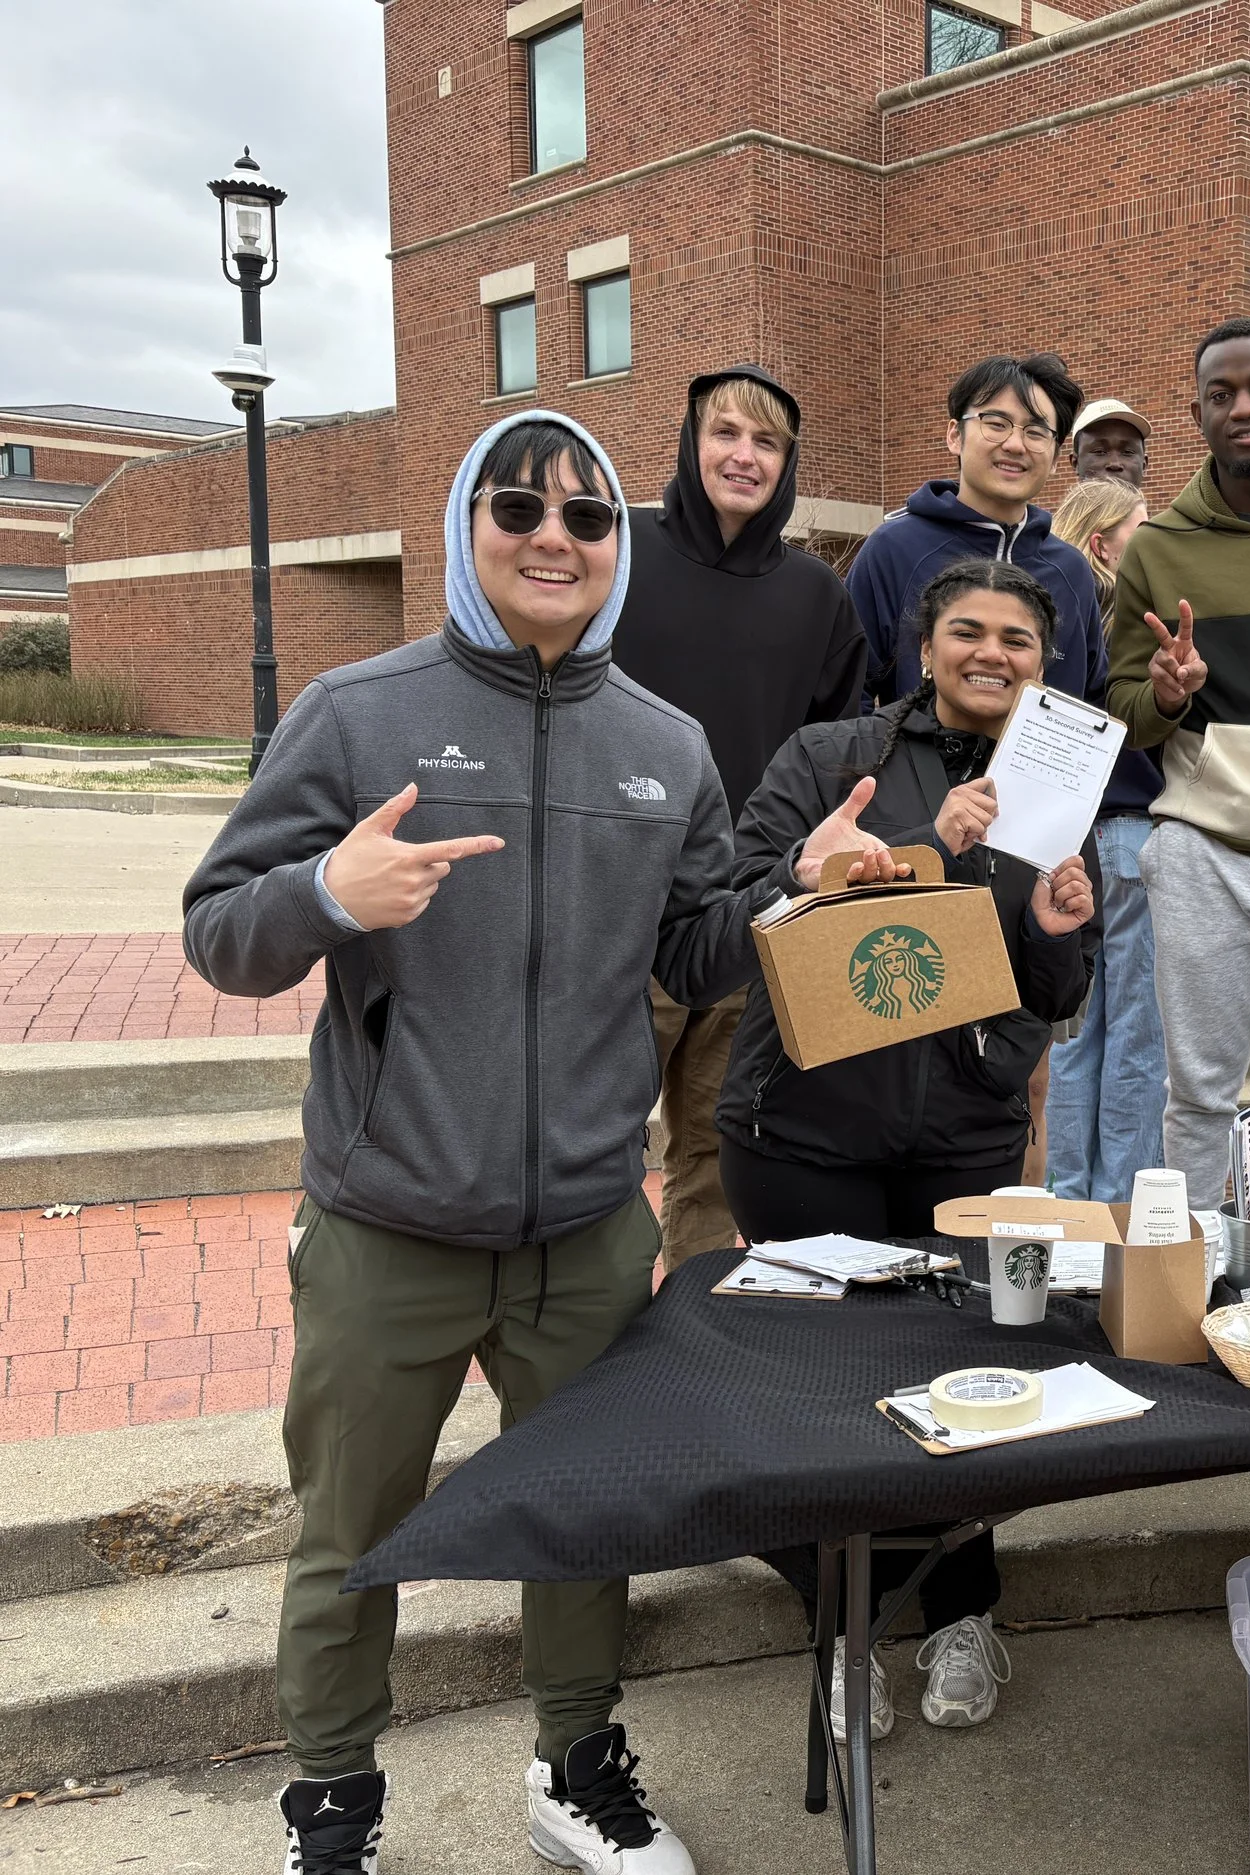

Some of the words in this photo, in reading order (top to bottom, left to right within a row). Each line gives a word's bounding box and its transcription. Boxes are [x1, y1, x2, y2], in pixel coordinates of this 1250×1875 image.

[1075, 727, 1095, 740] Survey
[418, 758, 486, 770] PHYSICIANS
[630, 775, 649, 786] THE
[618, 781, 649, 794] NORTH
[627, 790, 650, 800] FACE
